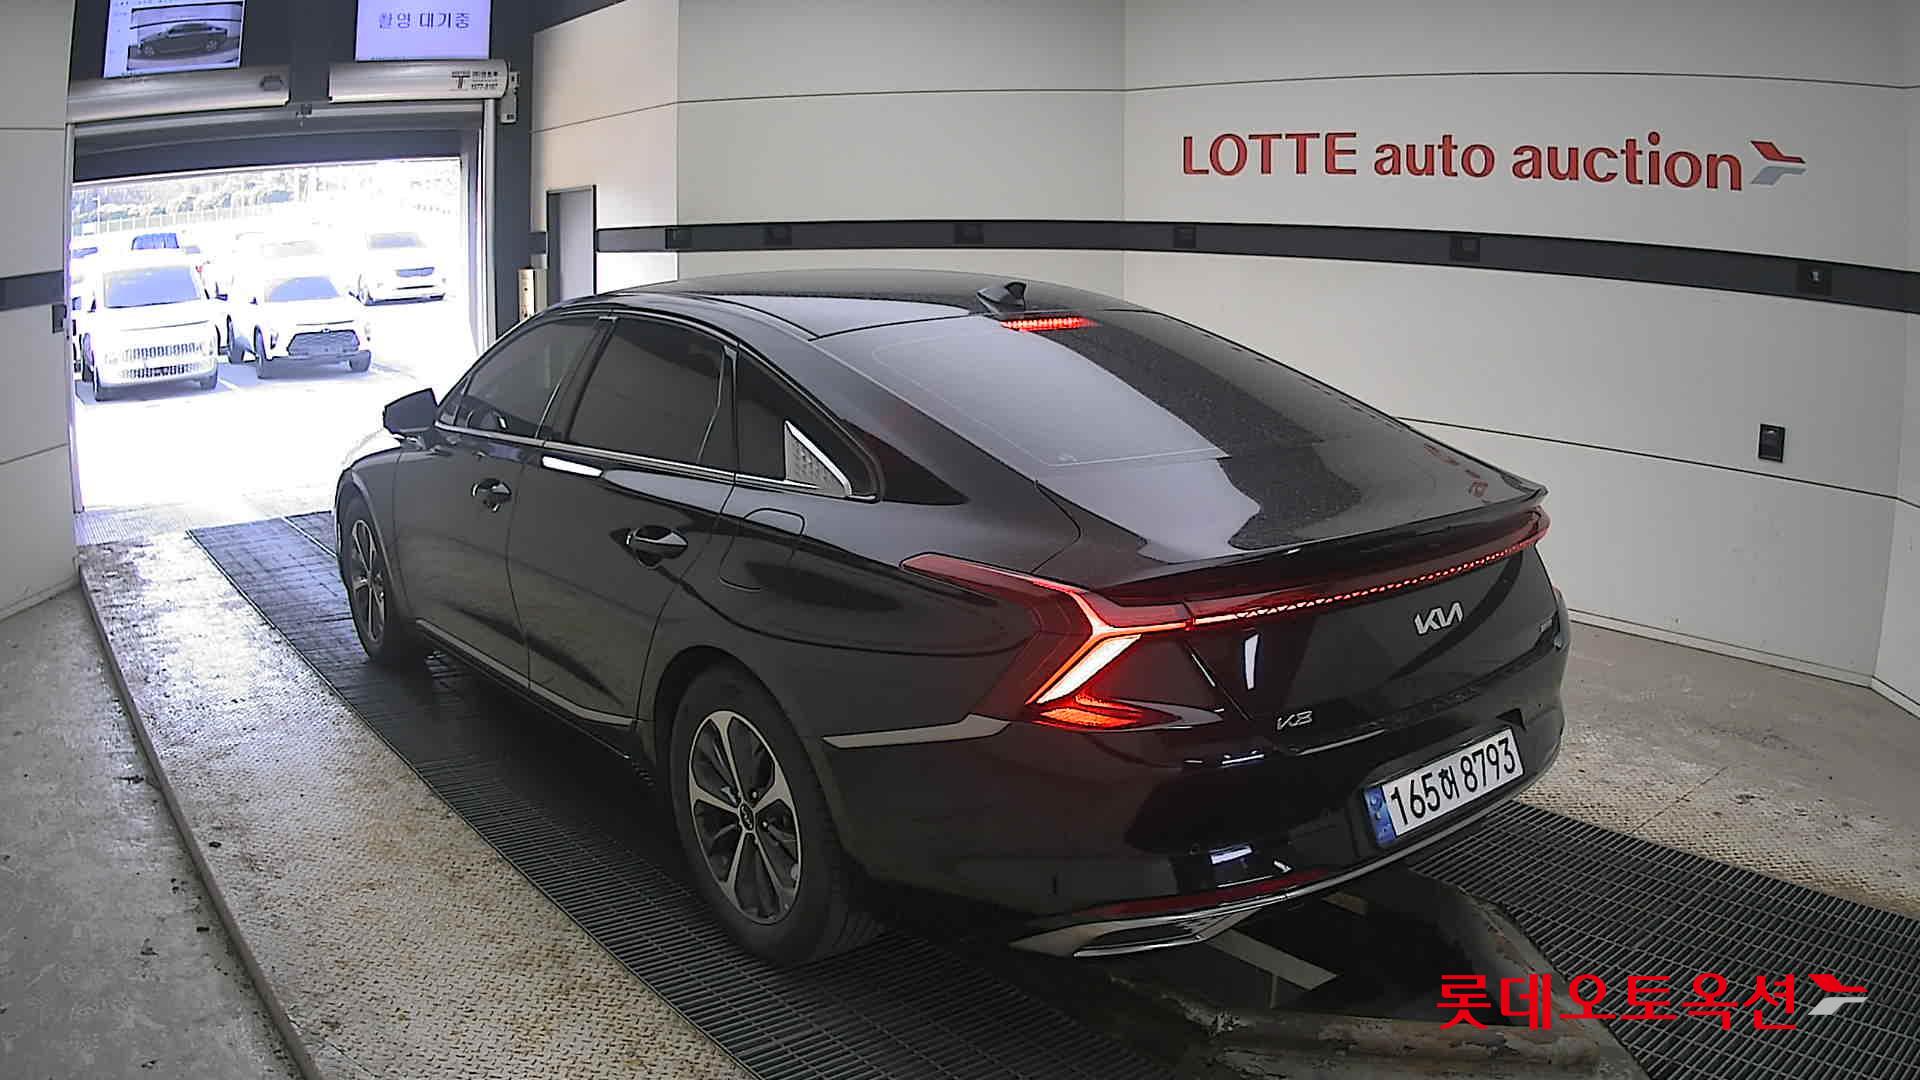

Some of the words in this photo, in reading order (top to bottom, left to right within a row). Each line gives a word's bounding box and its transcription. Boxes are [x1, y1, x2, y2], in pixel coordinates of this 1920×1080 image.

[419, 12, 470, 29] 대기중
[1183, 132, 1358, 177] LOTTE
[1373, 133, 1496, 178] auto
[1512, 131, 1744, 192] auction
[1414, 602, 1464, 635] KIA
[1277, 710, 1312, 730] K8
[1460, 737, 1516, 793] 8793
